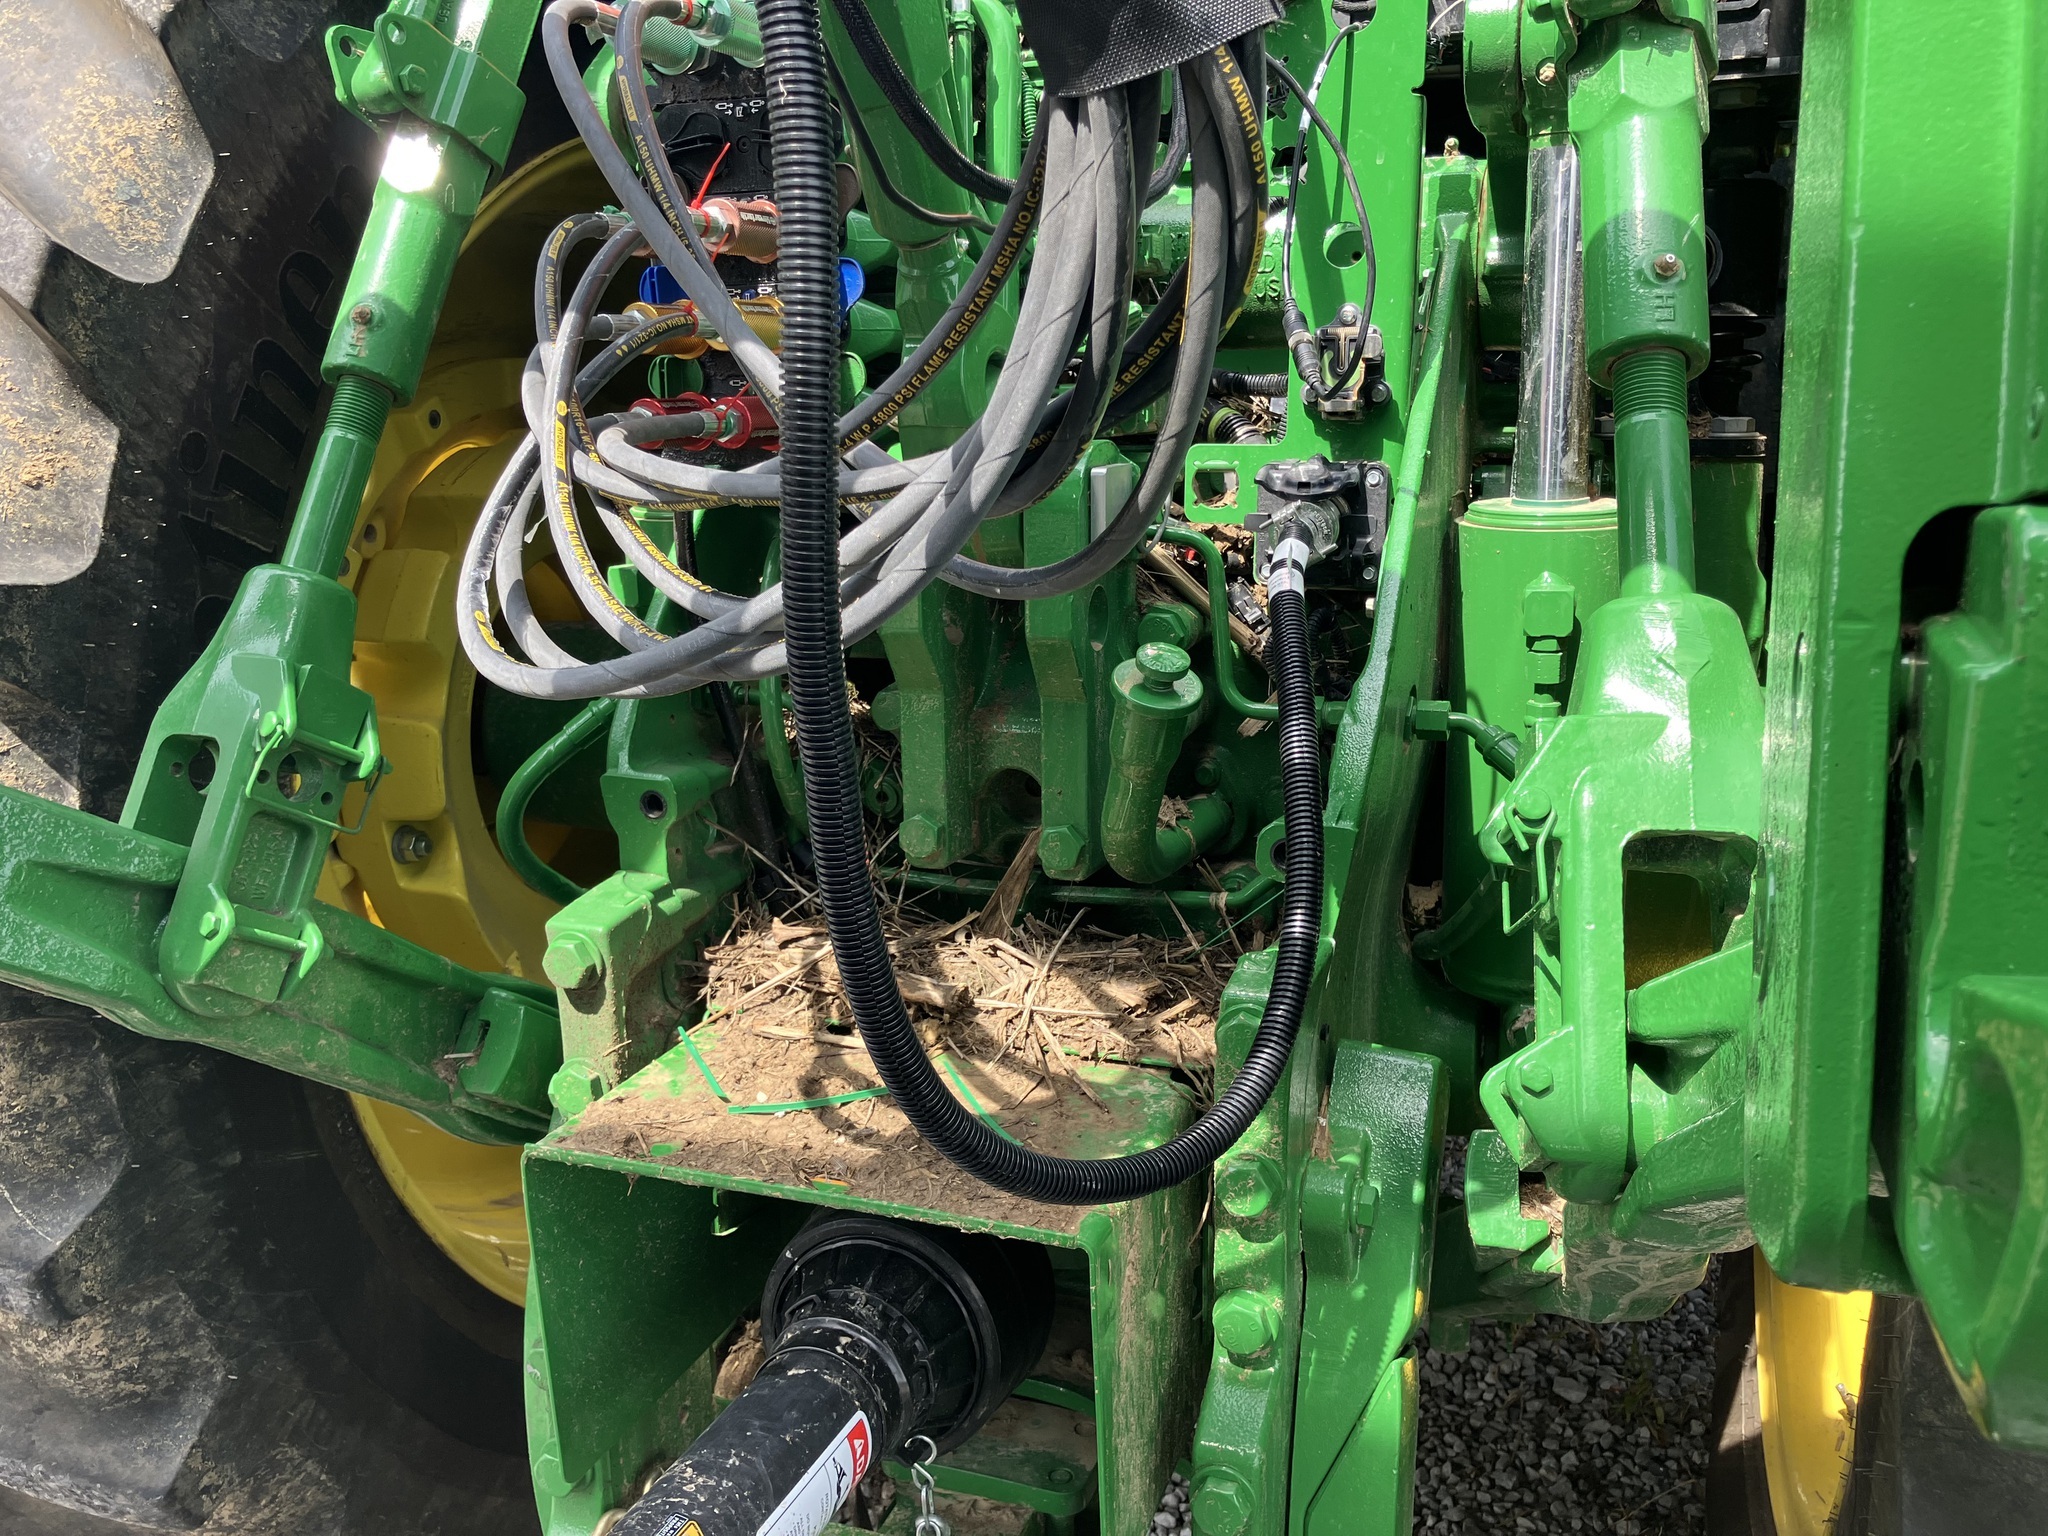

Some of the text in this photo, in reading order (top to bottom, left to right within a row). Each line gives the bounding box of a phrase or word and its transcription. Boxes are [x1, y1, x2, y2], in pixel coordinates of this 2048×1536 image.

[1214, 45, 1234, 73] 1/4
[1227, 76, 1258, 139] UHMW
[1251, 139, 1267, 184] A150
[635, 134, 650, 159] A150
[644, 159, 664, 193] UHMW
[659, 192, 671, 210] 1/4
[666, 209, 683, 236] INCH
[545, 265, 555, 281] A150
[545, 281, 556, 306] UHMW
[547, 306, 557, 320] 1/4
[668, 316, 687, 328] MSHA
[548, 320, 559, 341] INCH
[872, 402, 899, 425] 5800
[894, 384, 918, 405] PSI
[911, 347, 950, 387] FLAME
[944, 277, 997, 350] RESISTANT
[990, 236, 1020, 279] MSHA
[1121, 311, 1184, 383] RESISTANT
[557, 481, 569, 502] A150
[560, 504, 577, 533] UHMW
[568, 533, 582, 546] 1/4
[573, 546, 594, 570] INCH
[606, 599, 626, 615] SAE
